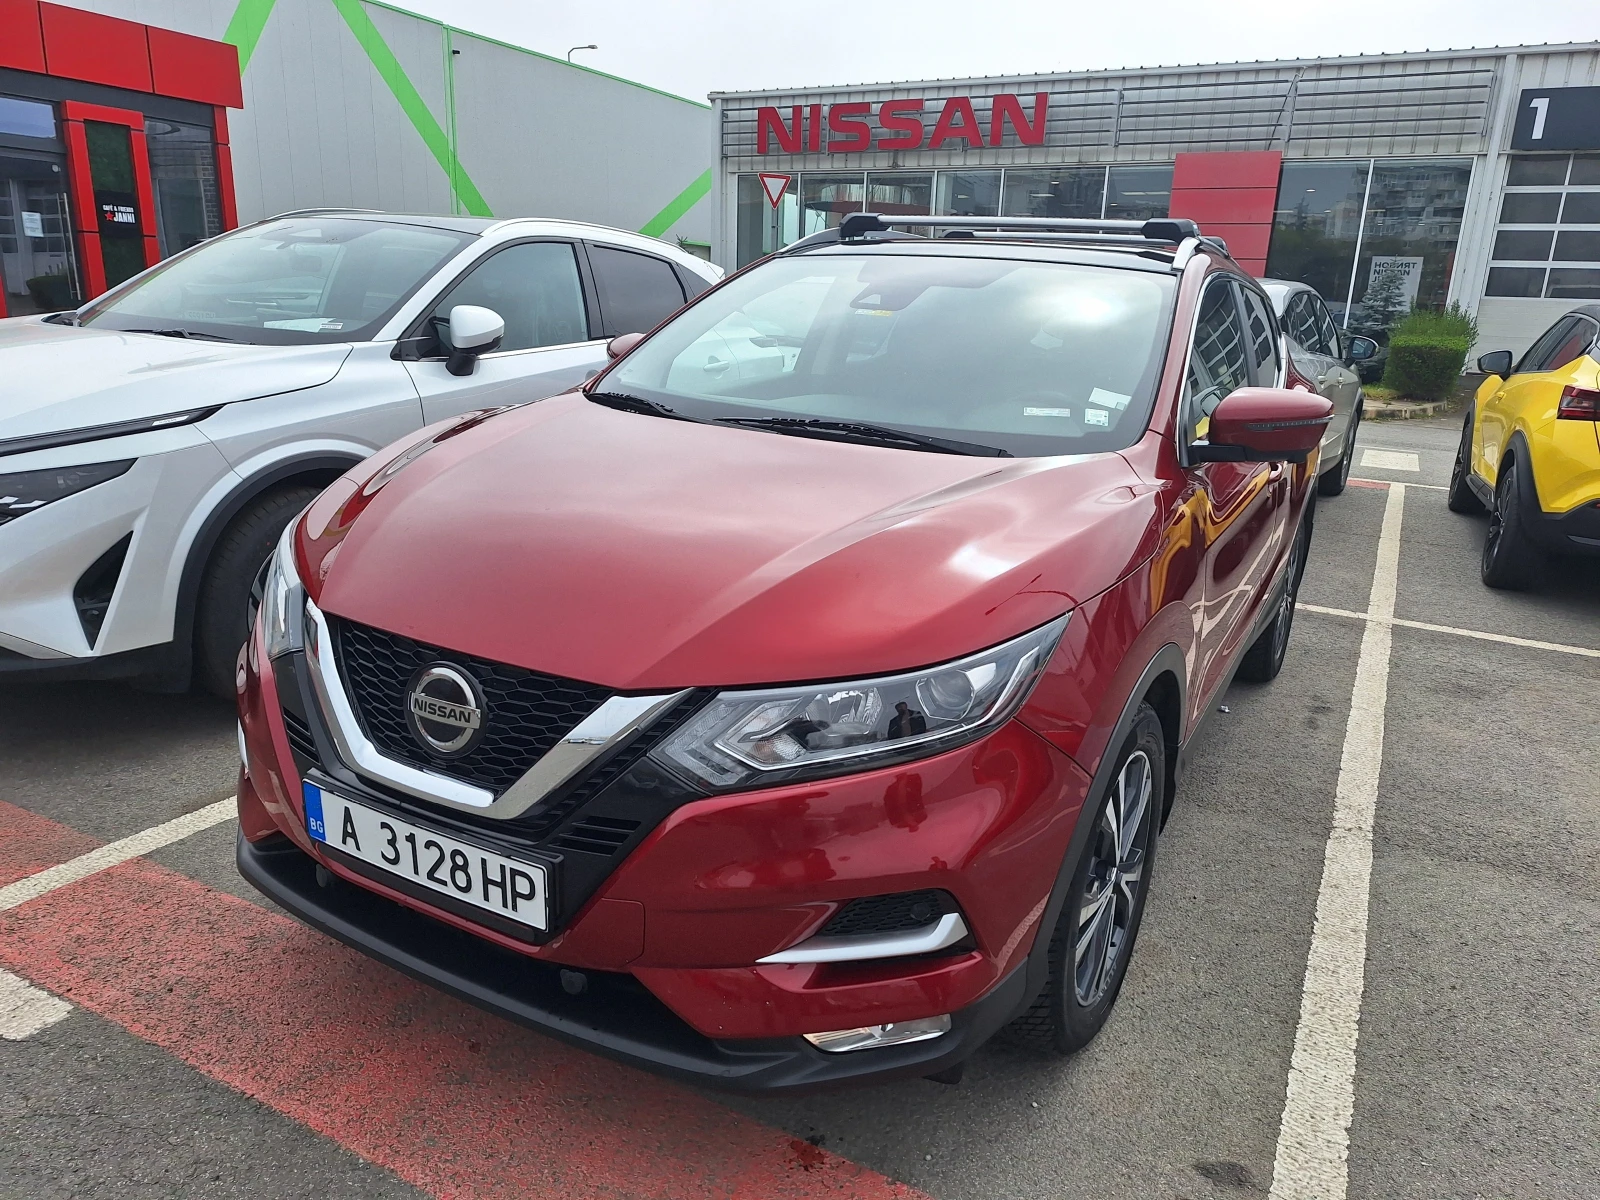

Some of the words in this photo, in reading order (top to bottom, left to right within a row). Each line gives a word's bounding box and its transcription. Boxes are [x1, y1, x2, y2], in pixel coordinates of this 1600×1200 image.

[757, 92, 1049, 155] NISSAN
[1529, 97, 1550, 140] 1
[114, 212, 135, 223] JANNI
[414, 697, 471, 723] NISSAN
[309, 817, 324, 834] BG
[341, 805, 362, 852] A
[380, 821, 472, 893] 3128
[481, 857, 536, 912] HP
